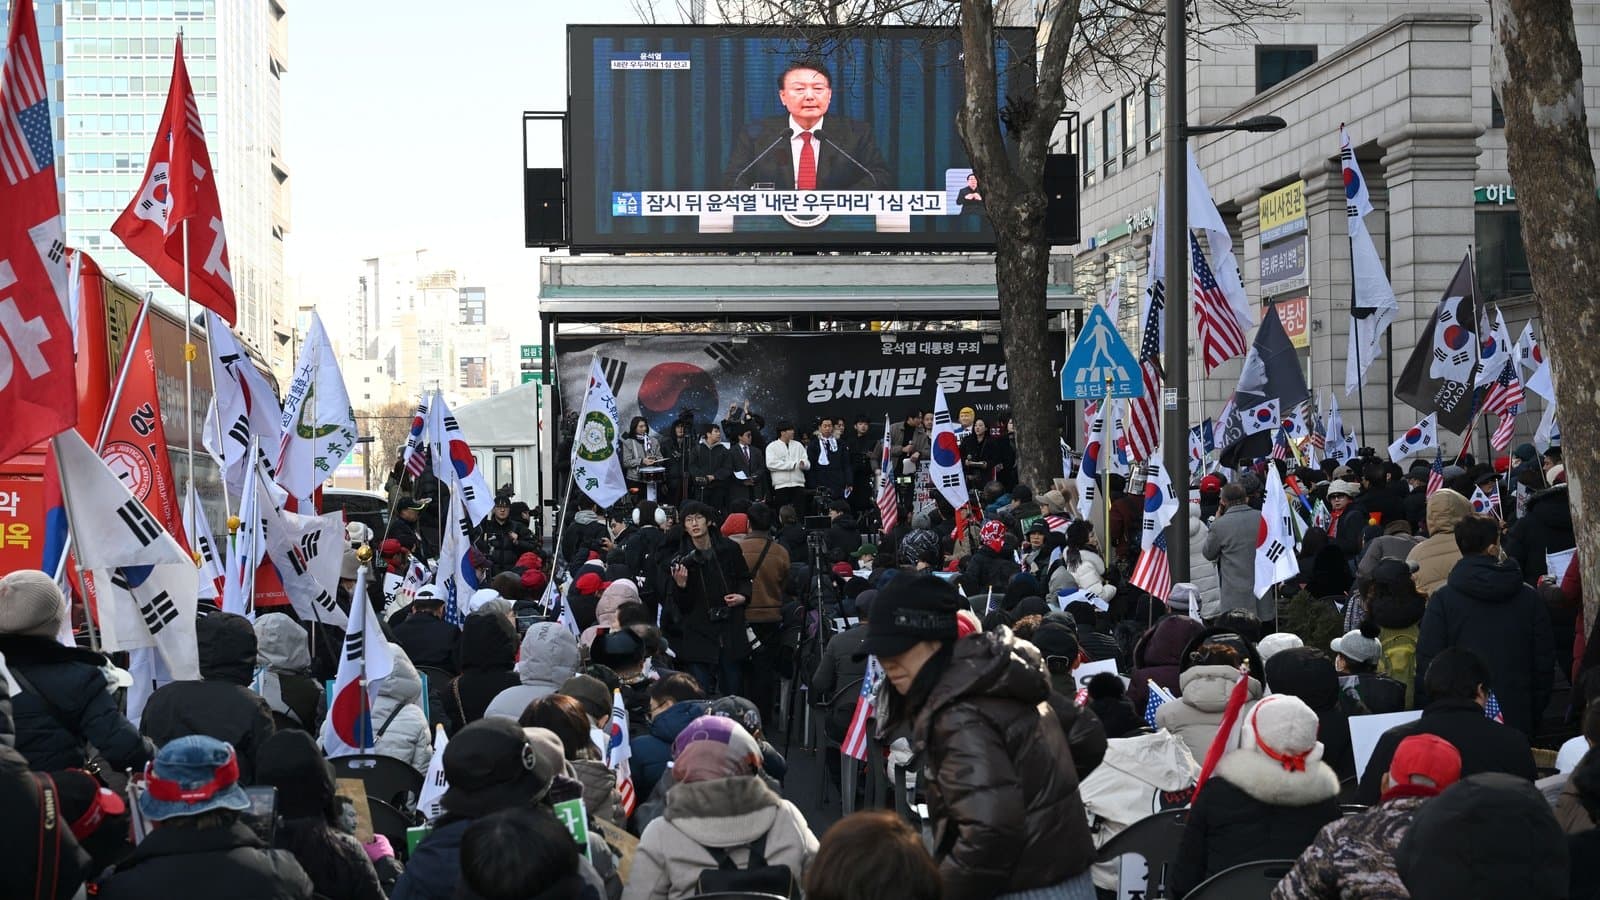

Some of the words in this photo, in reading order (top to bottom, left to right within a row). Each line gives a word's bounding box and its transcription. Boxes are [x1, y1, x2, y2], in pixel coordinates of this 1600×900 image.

[640, 52, 662, 60] 윤석열
[613, 61, 628, 69] 내란
[631, 61, 658, 69] 우두머리
[660, 61, 672, 69] 1심
[673, 61, 688, 69] 선고
[617, 197, 638, 206] 뉴스
[647, 195, 681, 213] 잠시
[685, 195, 702, 213] 뒤
[706, 194, 757, 213] 윤석열
[761, 194, 799, 213] '내란
[802, 194, 874, 213] 우두머리'
[878, 194, 903, 213] 1심
[908, 194, 942, 212] 선고
[881, 341, 917, 355] 윤석열
[919, 341, 954, 355] 대통령
[956, 341, 980, 354] 무죄
[807, 367, 927, 404] 정치재판
[975, 403, 994, 411] With
[44, 789, 55, 830] Canon
